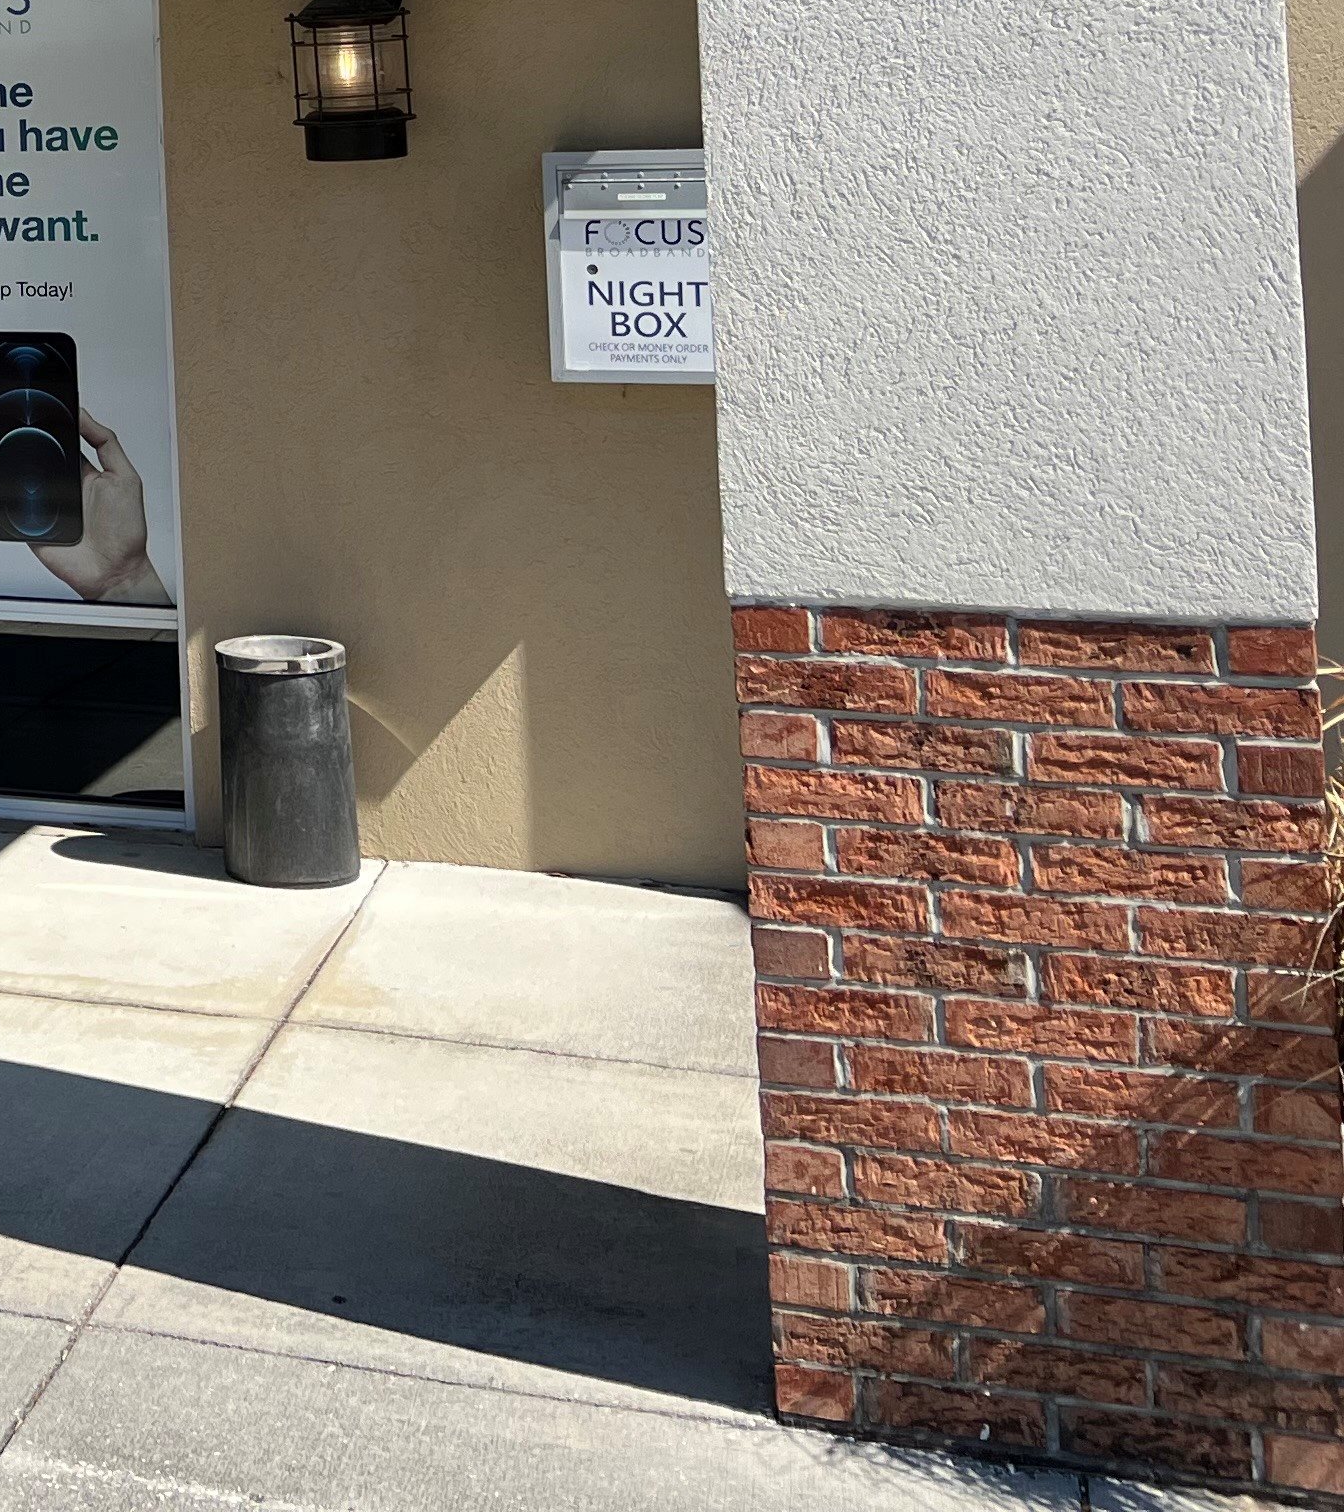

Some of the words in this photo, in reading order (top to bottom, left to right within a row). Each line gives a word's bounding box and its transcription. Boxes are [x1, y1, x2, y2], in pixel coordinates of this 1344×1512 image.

[19, 119, 119, 152] have
[585, 220, 705, 245] FOCUS
[585, 248, 705, 258] BROADBAND
[16, 282, 73, 300] Today!
[588, 280, 708, 307] NIGHT
[610, 311, 688, 338] BOX
[588, 342, 619, 352] CHECK
[622, 342, 635, 352] OR
[638, 343, 673, 352] MONEY
[675, 343, 709, 353] ORDER
[610, 354, 659, 363] PAYMENTS
[662, 354, 687, 364] ONLY
